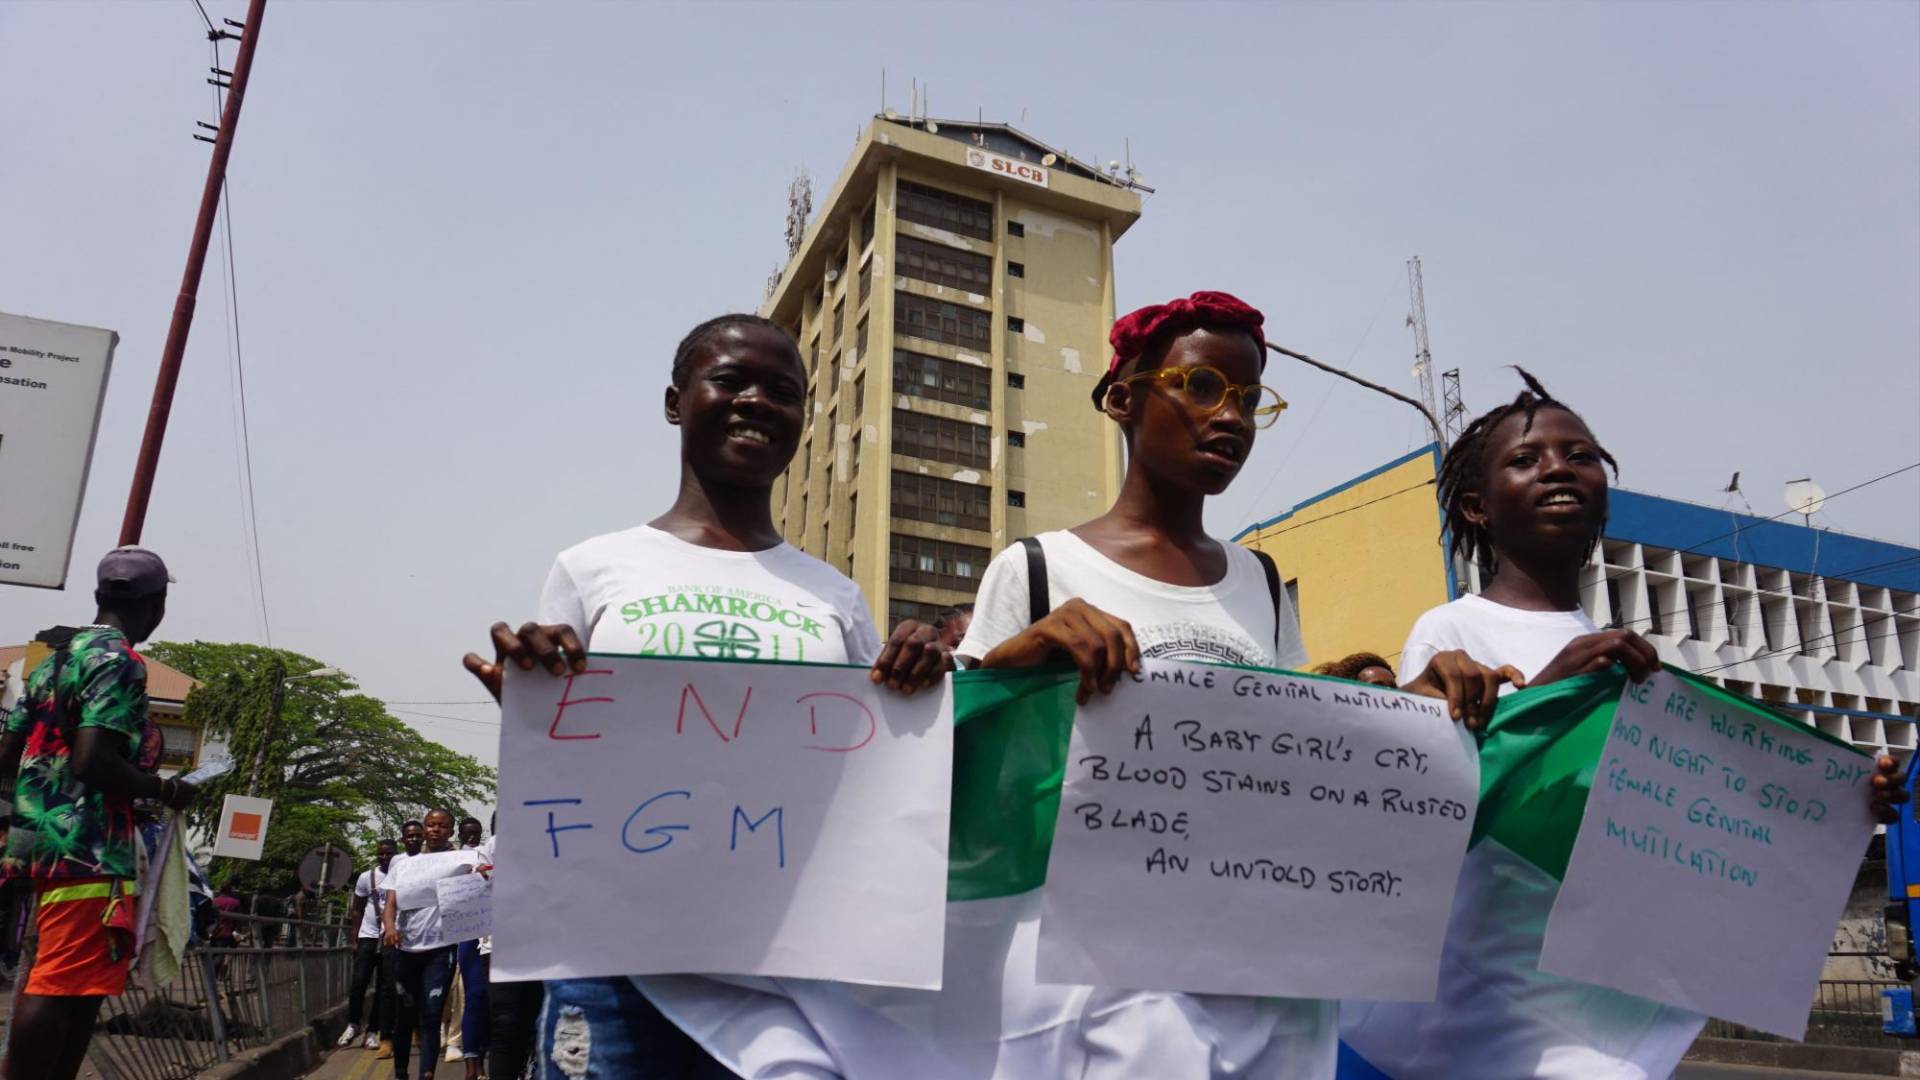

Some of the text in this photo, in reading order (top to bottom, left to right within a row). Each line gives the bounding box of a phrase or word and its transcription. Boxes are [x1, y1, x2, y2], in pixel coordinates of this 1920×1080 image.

[991, 158, 1043, 182] SLCB
[10, 346, 45, 359] Mobility
[47, 352, 80, 363] Project
[12, 542, 35, 552] free
[620, 593, 826, 641] SHAMROCK
[667, 584, 783, 606] BANK OF AMERICA
[548, 669, 876, 752] END
[1131, 669, 1441, 717] EMALE GENITAL MUTILATION
[1134, 713, 1154, 751] A
[1174, 720, 1261, 752] BABY
[1375, 747, 1429, 775] CRY,
[1664, 691, 1697, 721] ARE
[1710, 713, 1814, 765] WORKING
[1079, 755, 1467, 821] BLOOD STAINS ON A RUSTED
[1613, 717, 1827, 822] AND NIGHT TO STOP
[1074, 803, 1191, 840] BLADE,
[1608, 757, 1774, 845] FEMALE GENITAL
[523, 791, 785, 869] FGM
[1606, 817, 1758, 888] MUTILATION
[1145, 848, 1402, 898] AN UNTOLD STORY.
